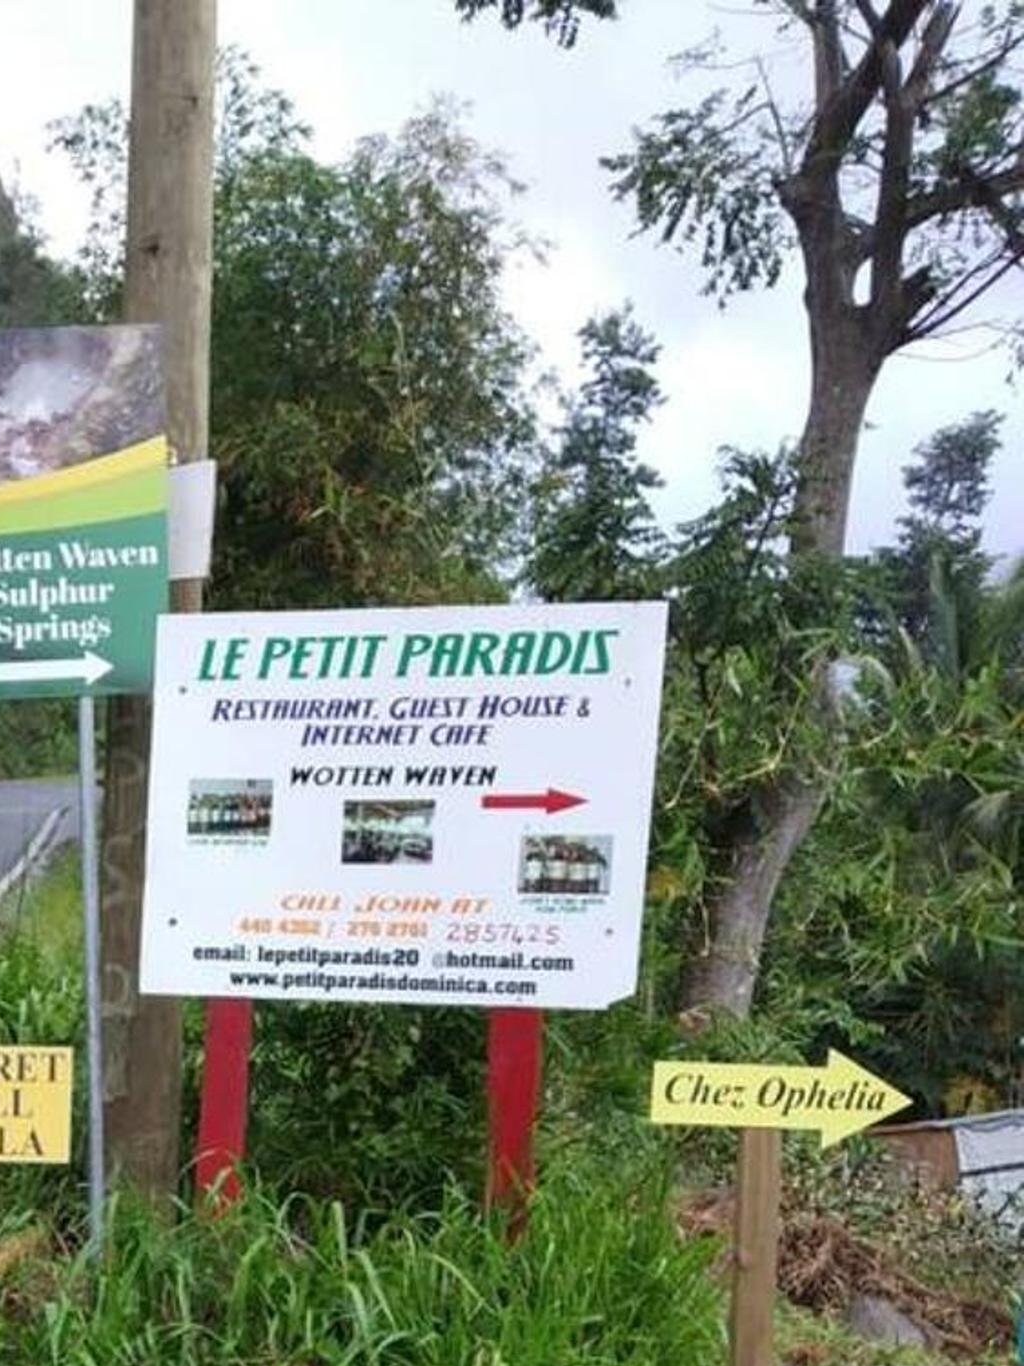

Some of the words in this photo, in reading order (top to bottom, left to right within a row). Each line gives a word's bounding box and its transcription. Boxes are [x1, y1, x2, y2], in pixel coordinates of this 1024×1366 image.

[59, 541, 159, 569] Waven
[198, 637, 250, 681] LE
[256, 635, 388, 680] PETIT
[396, 630, 619, 677] PARADIS
[389, 696, 470, 720] GUEST
[477, 695, 570, 719] HOUSE
[576, 698, 591, 718] &
[301, 723, 423, 747] INTERNET
[429, 722, 494, 747] CAFE
[290, 766, 394, 787] WOTTEN
[404, 765, 498, 787] WAVEN
[279, 895, 341, 911] CALL
[354, 896, 442, 913] JOHN
[450, 897, 491, 913] AT
[192, 945, 252, 961] email:
[257, 945, 420, 968] lepetitparadis20
[229, 971, 538, 995] www.petitparadisdominica.com
[665, 1073, 747, 1109] Chez
[757, 1076, 887, 1117] Ophelia
